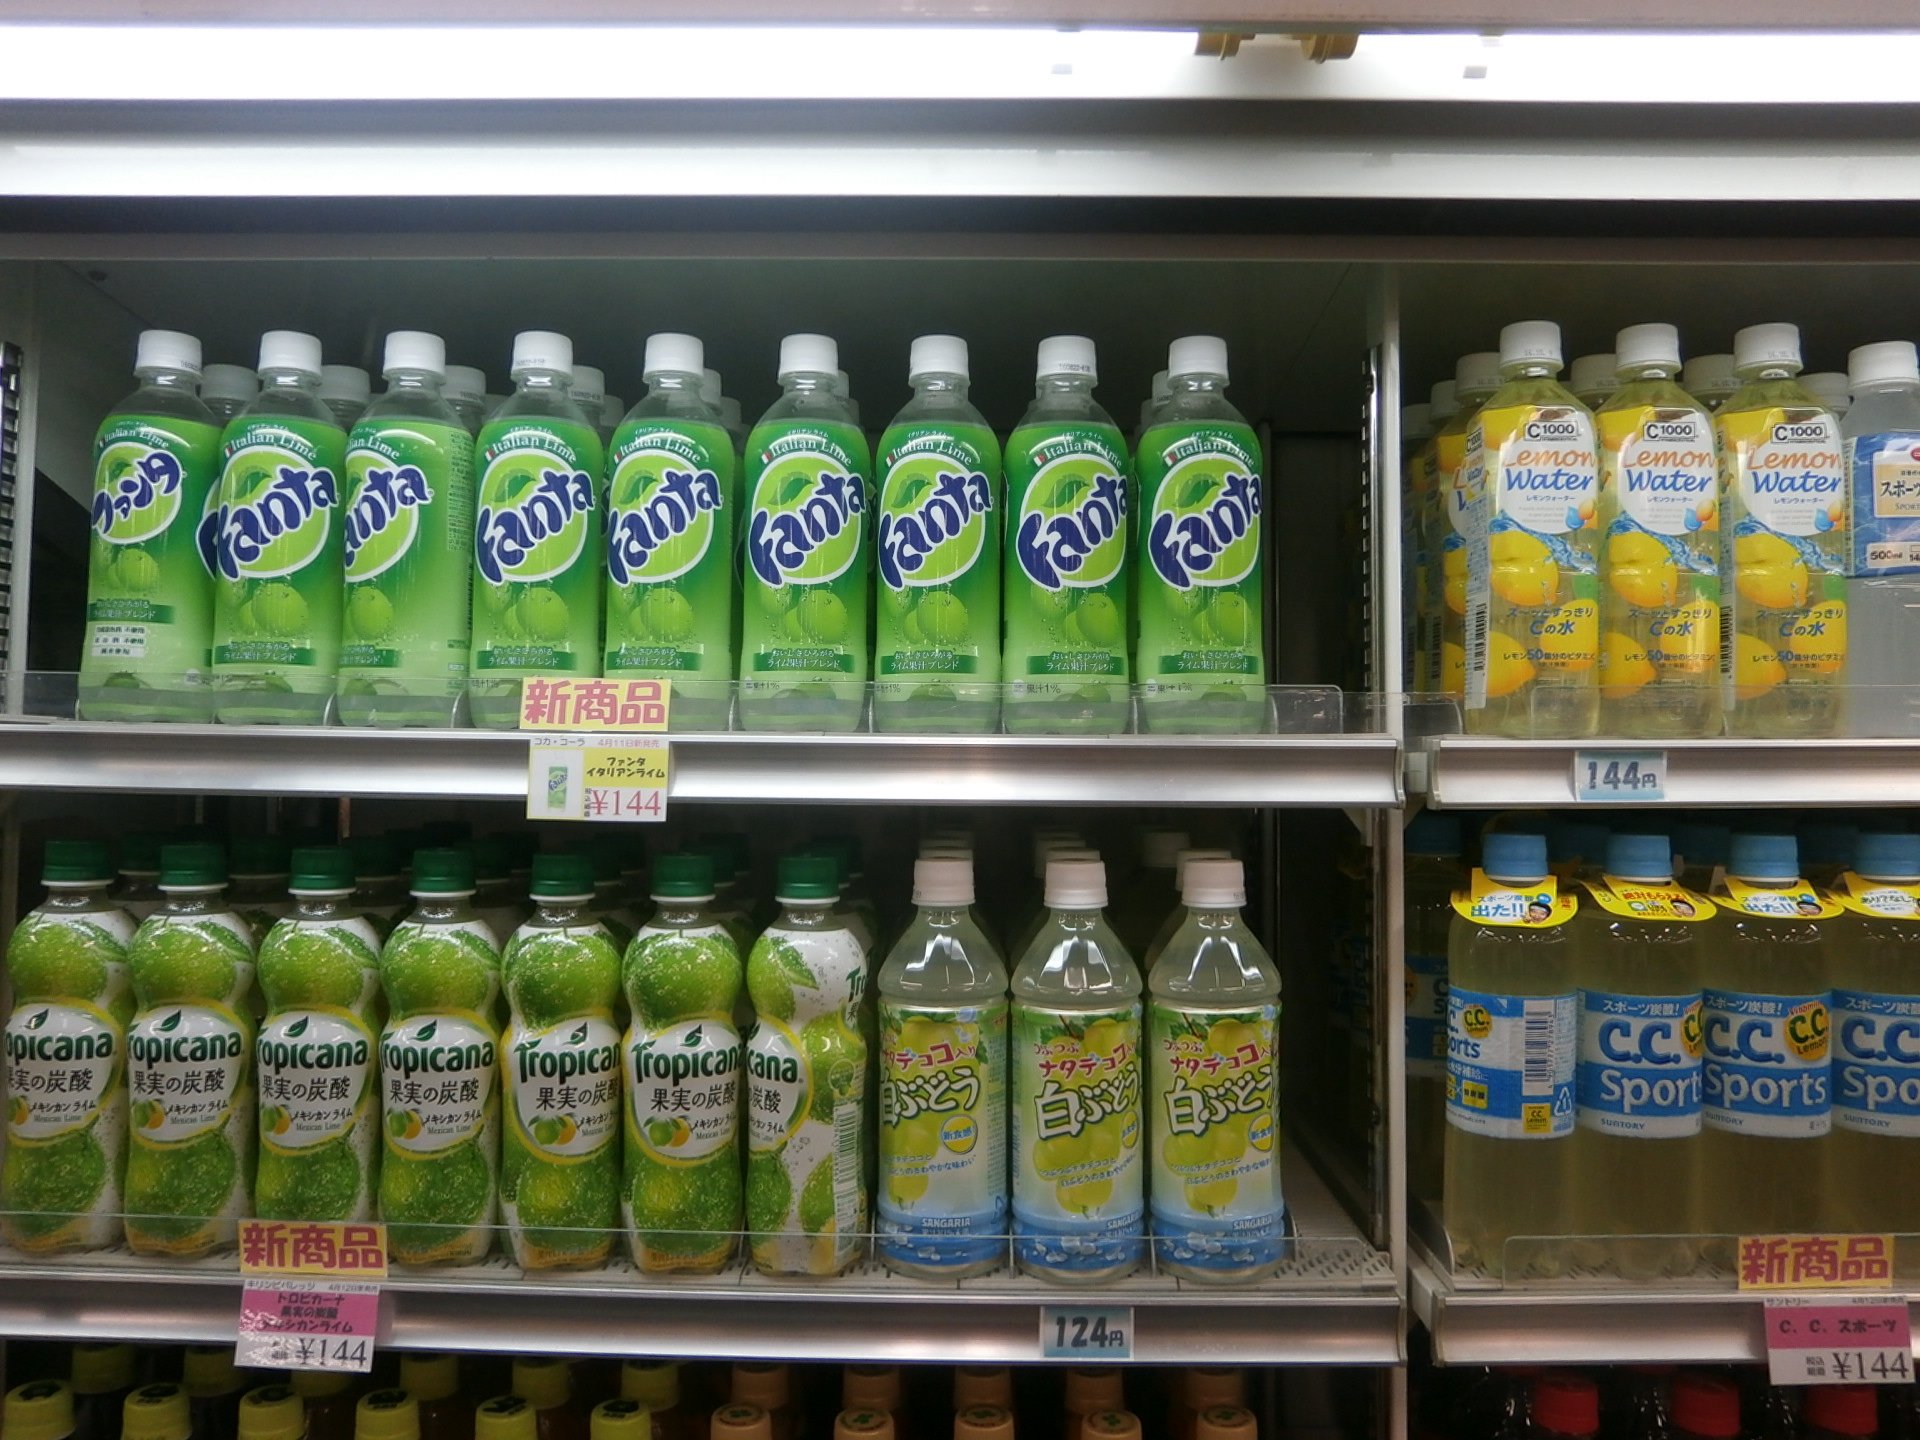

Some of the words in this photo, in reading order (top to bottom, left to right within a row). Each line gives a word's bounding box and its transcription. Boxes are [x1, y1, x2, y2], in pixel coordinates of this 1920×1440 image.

[231, 431, 276, 450] Italian
[280, 433, 318, 461] Lime
[1527, 422, 1576, 440] C1000
[1645, 423, 1693, 440] C1000
[1774, 424, 1824, 441] C1000
[492, 435, 541, 455] Italian
[545, 437, 577, 463] Lime
[771, 437, 819, 458] Italian
[821, 438, 852, 467] Lime
[1745, 449, 1841, 471] Lemon
[91, 451, 182, 535] ファンタ
[1505, 467, 1595, 491] Water
[1626, 470, 1712, 492] Water
[1751, 471, 1842, 494] Water
[217, 465, 339, 580] Fanta
[477, 469, 596, 584] Fanta
[609, 470, 722, 586] Fanta
[749, 471, 866, 587] Fanta
[879, 472, 993, 590] Fanta
[1017, 474, 1128, 590] Fanta
[1148, 473, 1263, 590] Fanta
[525, 680, 666, 725] 新商品
[534, 736, 586, 747] コカ・コーラ
[586, 767, 666, 778] イタリアンライム
[605, 756, 647, 766] ファンタ
[1587, 760, 1658, 790] 144円
[590, 789, 663, 817] ¥144
[1603, 998, 1681, 1017] スポーツ炭酸!
[1450, 1036, 1481, 1060] orts
[1598, 1017, 1682, 1065] C.C.
[1704, 1015, 1785, 1064] C.C.
[513, 1037, 621, 1086] Tropican
[631, 1039, 744, 1088] Tropican
[133, 1067, 226, 1095] 果実の炭酸
[261, 1075, 352, 1102] 果実の炭酸
[389, 1078, 480, 1105] 果実の炭酸
[1600, 1068, 1703, 1114] Sport
[1704, 1063, 1827, 1110] Sports
[1842, 1065, 1920, 1111] Spo
[651, 1081, 738, 1112] 果実の炭酸
[1034, 1060, 1139, 1142] 白ぶどう
[291, 1111, 332, 1123] メキシカン
[423, 1113, 463, 1127] メキシカン
[1600, 1117, 1647, 1130] SUNTORY
[922, 1216, 971, 1229] SANGARIA
[243, 1223, 384, 1269] 新商品
[1741, 1236, 1890, 1285] 新商品
[277, 1292, 346, 1306] トロピカーナ
[1056, 1316, 1126, 1348] 124円
[295, 1337, 368, 1367] ¥144
[1831, 1350, 1911, 1381] ¥144
